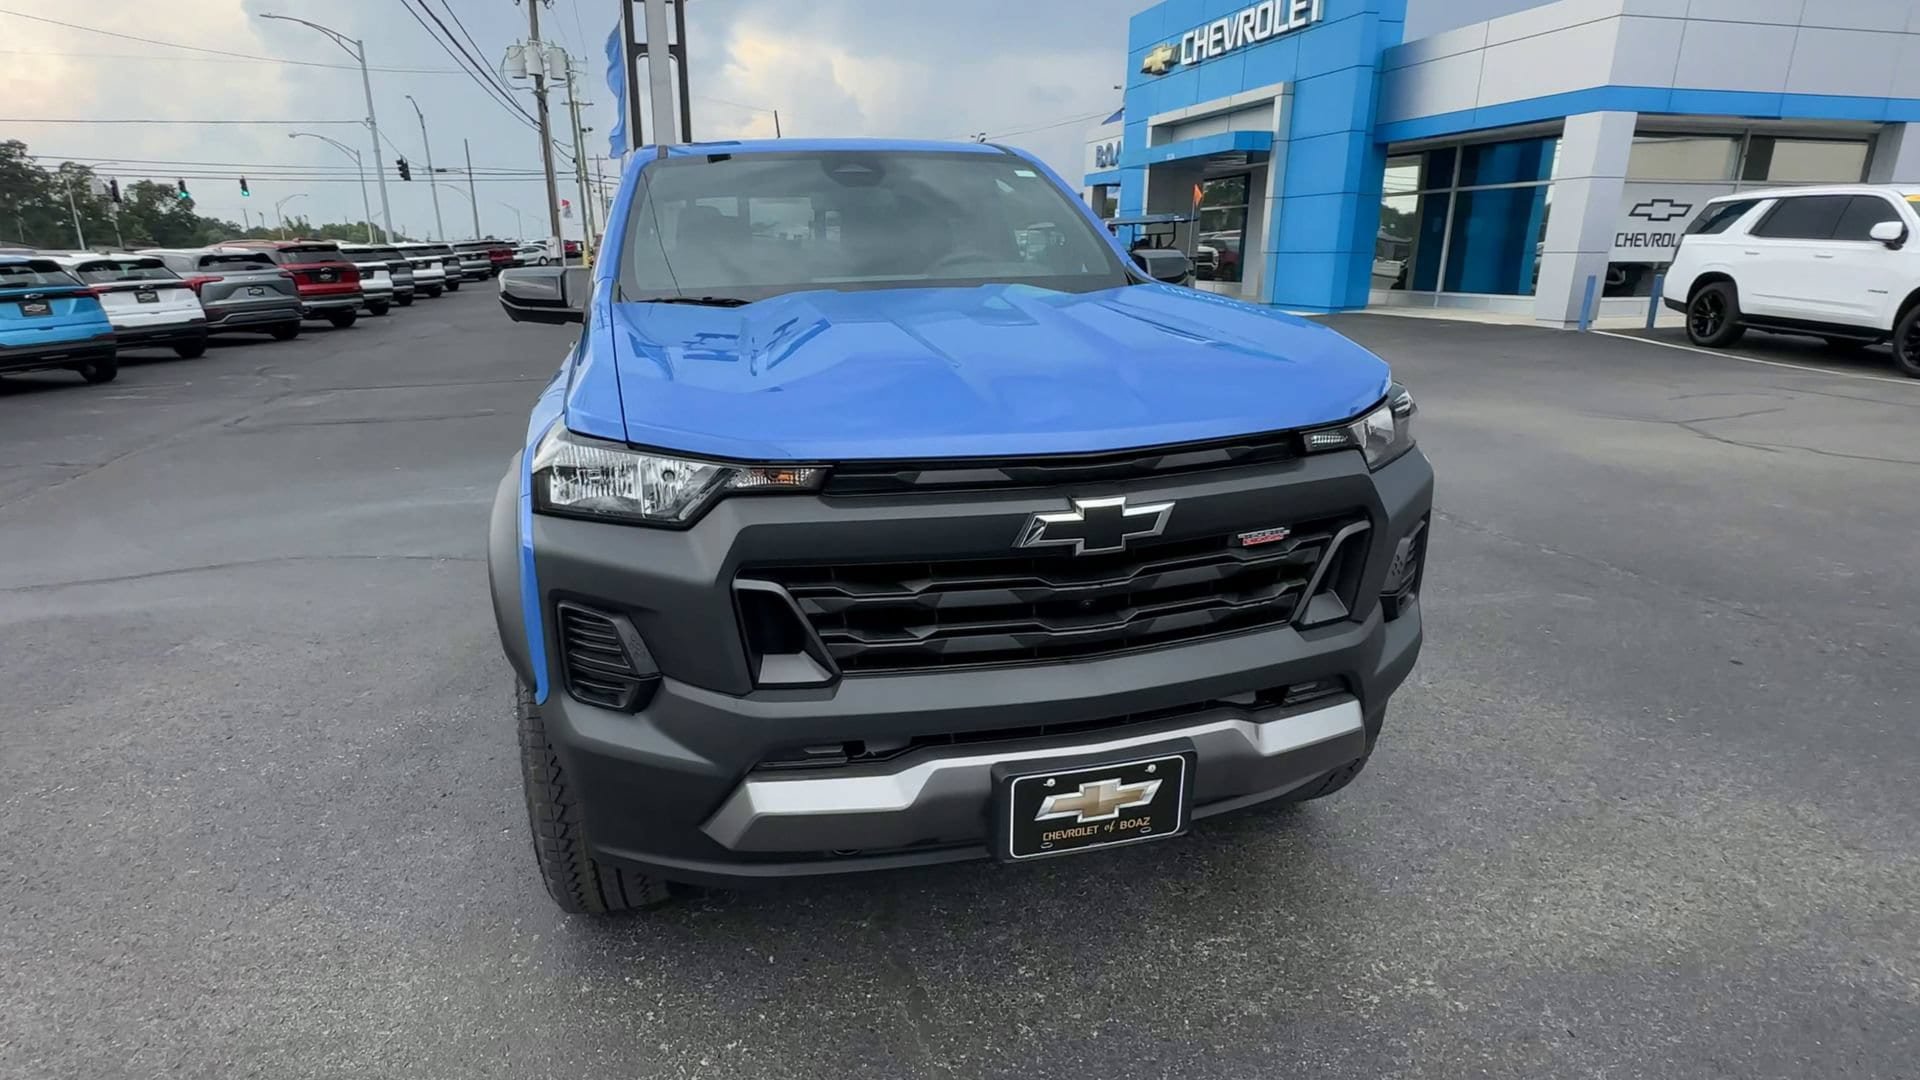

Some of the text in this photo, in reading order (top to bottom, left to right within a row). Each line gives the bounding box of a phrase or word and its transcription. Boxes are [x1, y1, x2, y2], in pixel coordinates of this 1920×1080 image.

[1042, 816, 1151, 841] CHEVROLET of BOAZ
